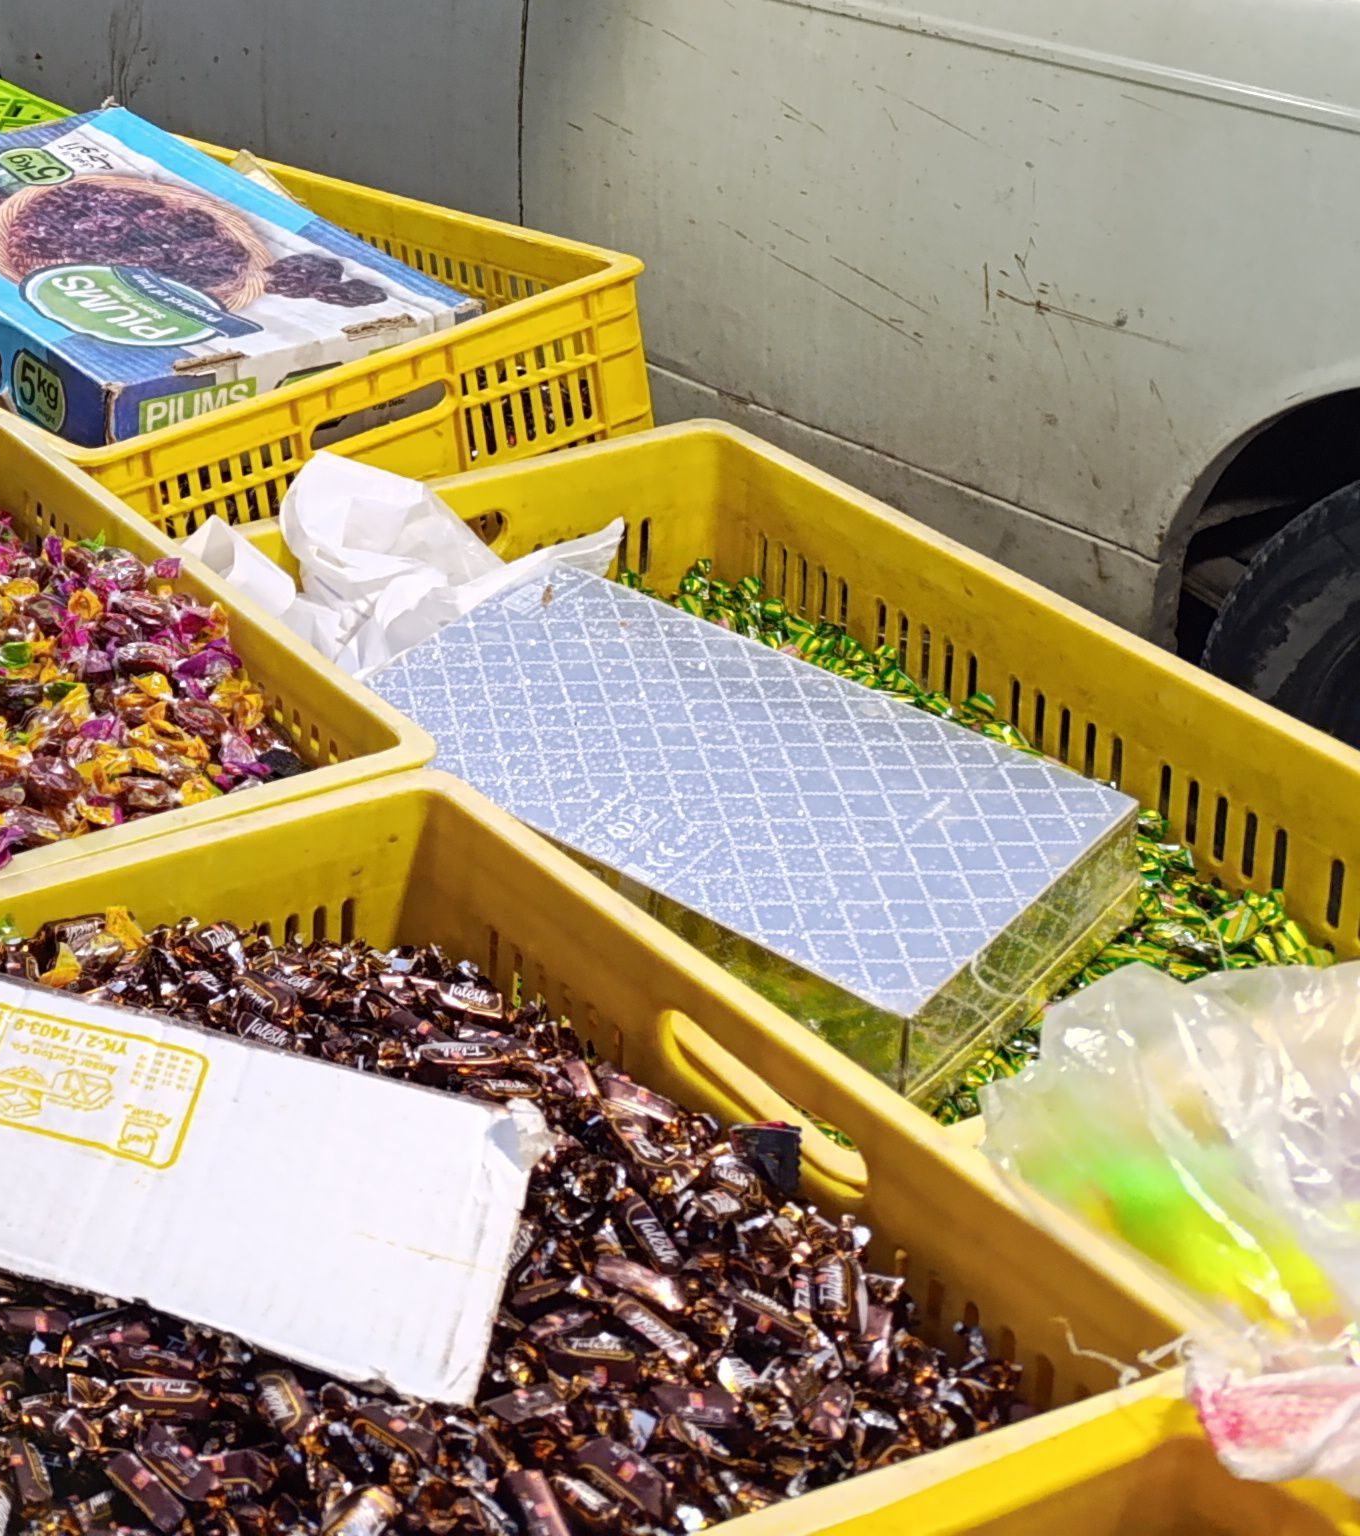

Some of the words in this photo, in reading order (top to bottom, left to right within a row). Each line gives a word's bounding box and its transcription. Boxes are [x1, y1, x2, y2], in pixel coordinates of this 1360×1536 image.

[172, 296, 223, 323] Product
[449, 983, 494, 1006] Talesh
[245, 1017, 292, 1047] Talesh
[632, 1214, 679, 1264] Talesh
